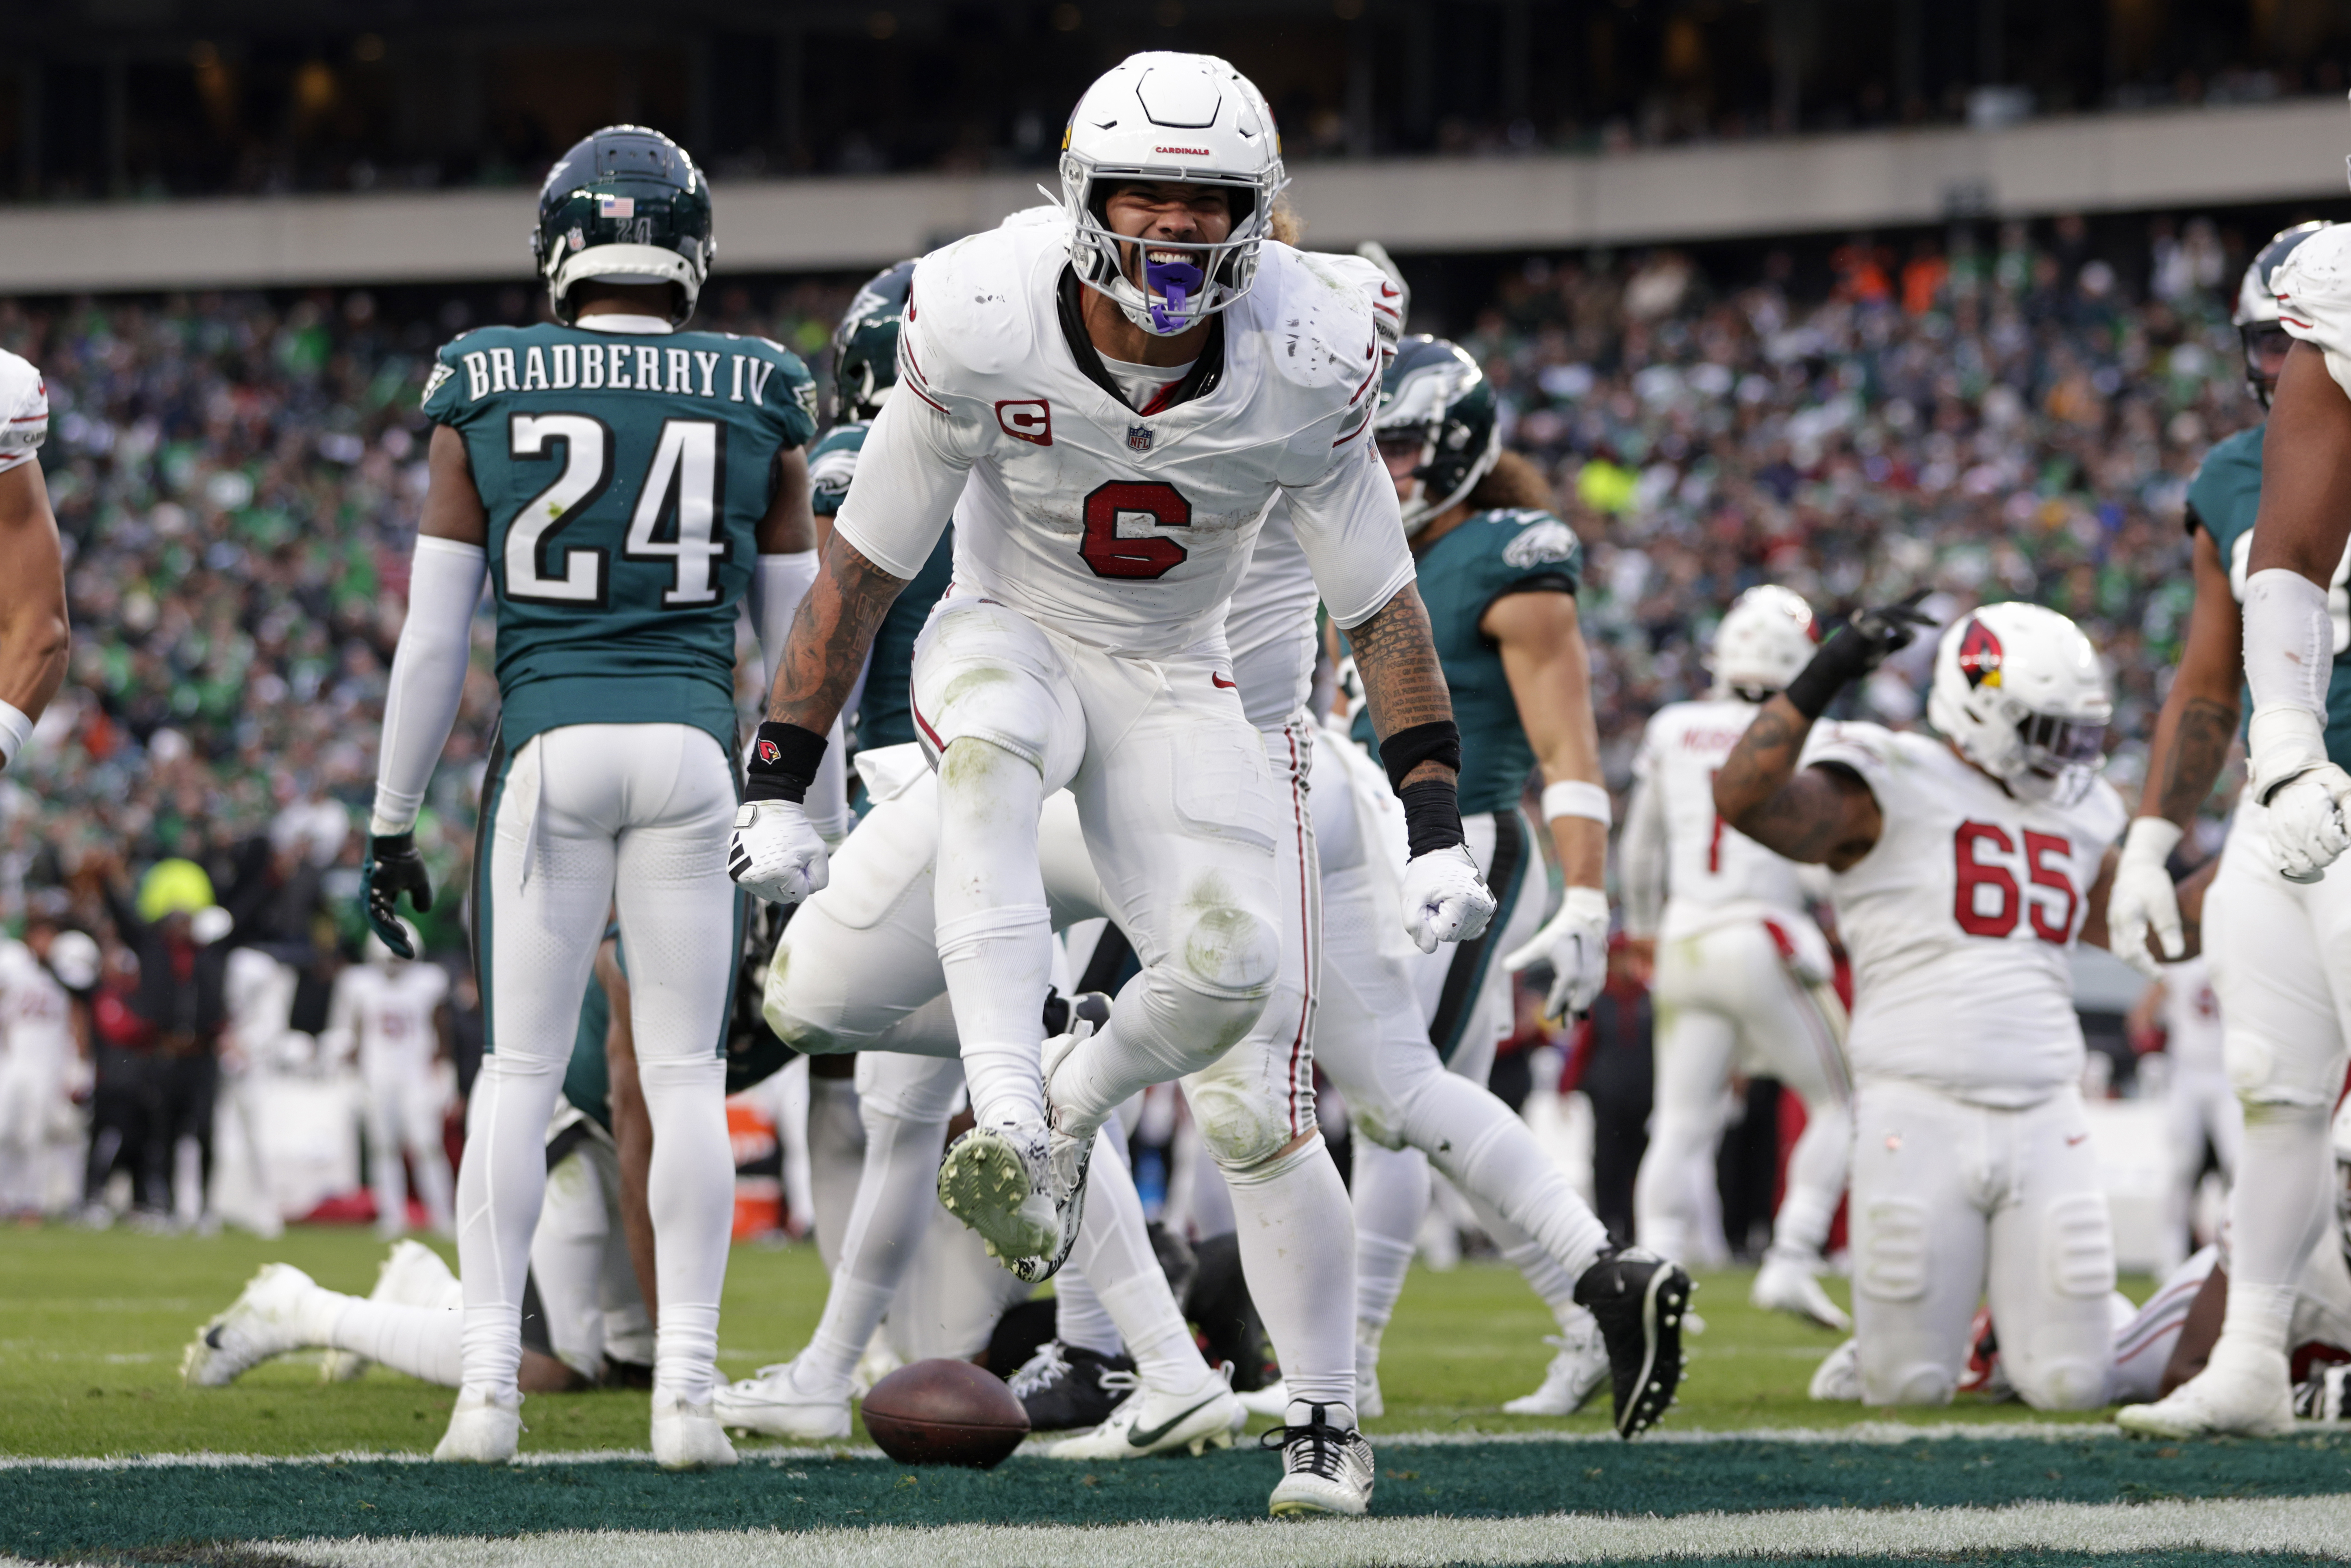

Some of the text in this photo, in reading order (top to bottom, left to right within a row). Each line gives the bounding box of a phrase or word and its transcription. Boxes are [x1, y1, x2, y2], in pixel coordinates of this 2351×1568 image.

[1155, 147, 1209, 155] CARDINALS
[462, 344, 775, 407] BRADBERRY IV
[1130, 437, 1148, 449] NFL
[503, 411, 735, 610] 24
[1077, 479, 1192, 580] 6
[1955, 821, 2077, 944] 65
